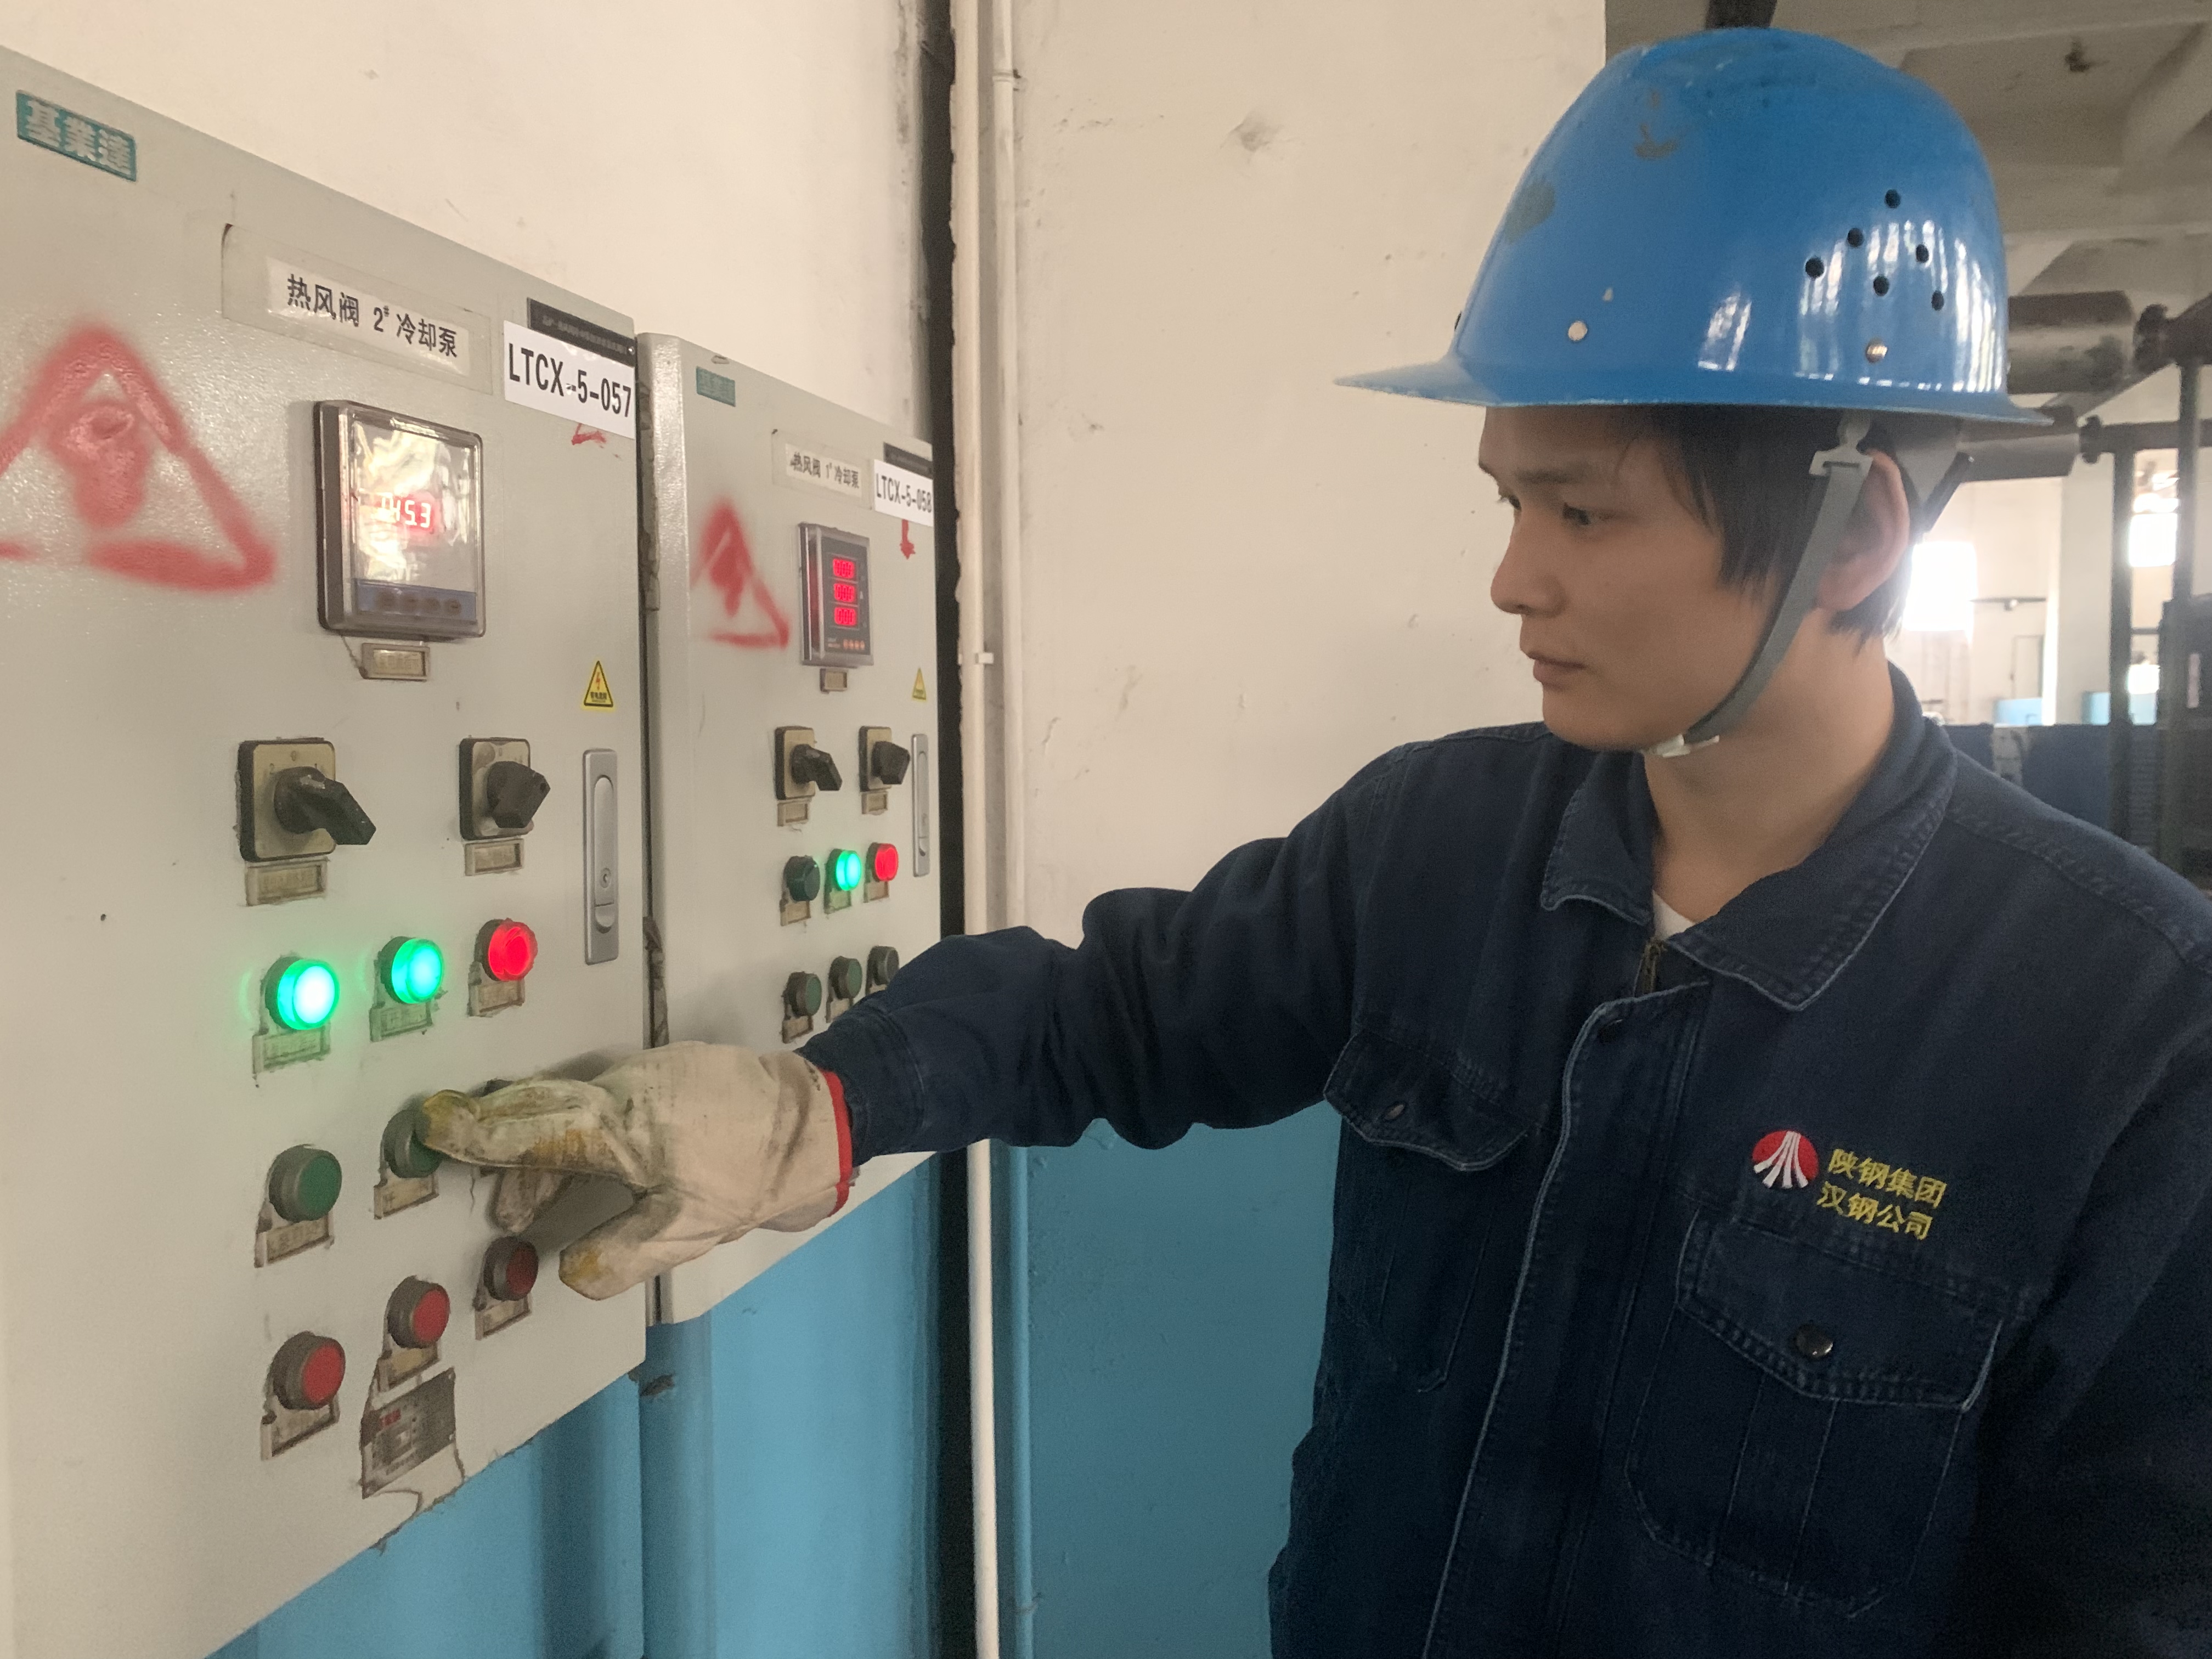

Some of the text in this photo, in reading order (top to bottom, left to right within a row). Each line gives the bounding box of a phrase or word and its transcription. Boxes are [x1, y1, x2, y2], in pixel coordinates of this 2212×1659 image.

[287, 274, 359, 327] 热风阀
[396, 313, 458, 358] 冷却泵
[509, 342, 632, 417] LTCX-5-057
[876, 472, 932, 514] LTCX-5-058
[1827, 1148, 1947, 1209] 陕钢集团
[1816, 1181, 1933, 1240] 汉钢公司
